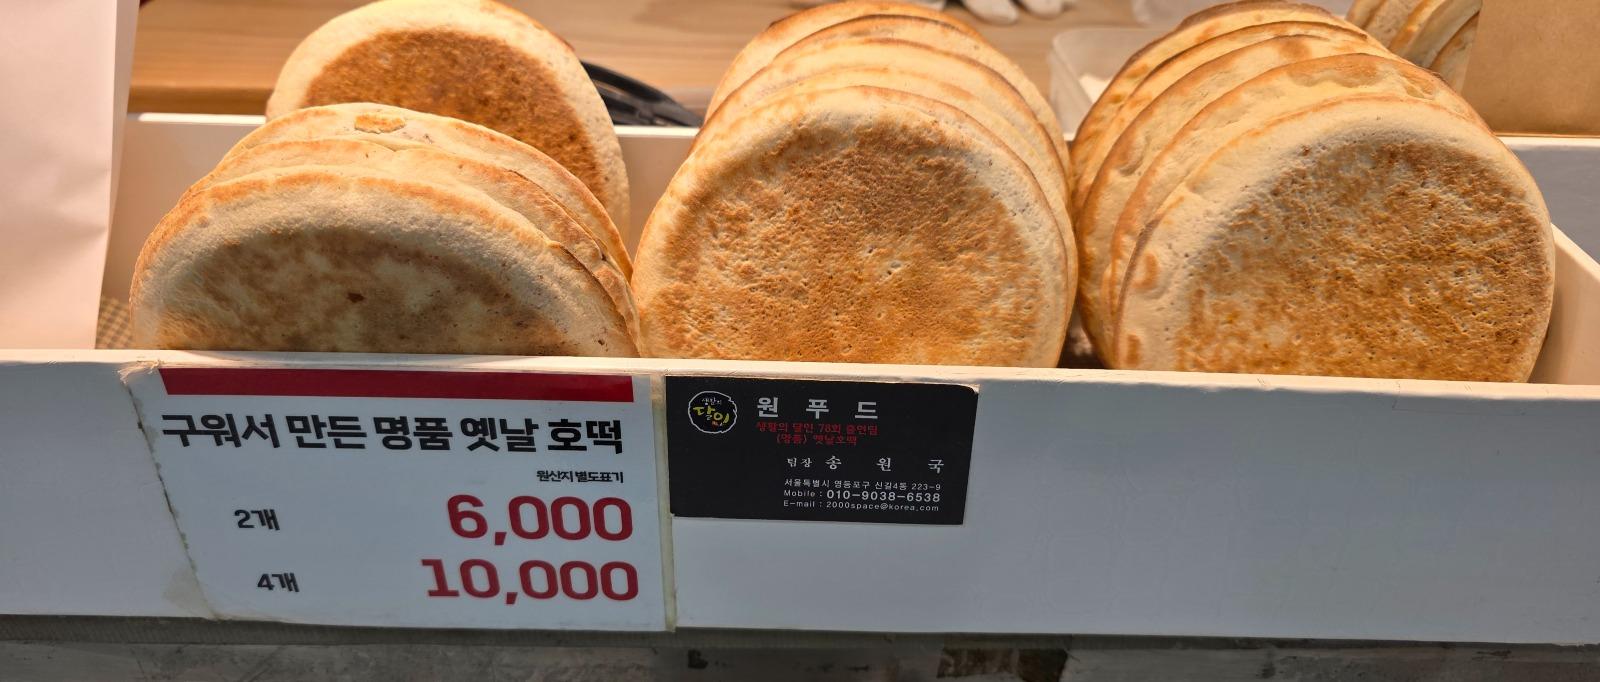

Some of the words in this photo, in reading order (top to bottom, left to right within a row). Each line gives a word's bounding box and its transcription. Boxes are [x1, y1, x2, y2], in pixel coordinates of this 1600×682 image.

[161, 413, 280, 449] 구워서
[287, 414, 368, 451] 만든
[373, 415, 453, 451] 명품
[460, 416, 539, 453] 옛날
[547, 418, 623, 455] 호떡
[818, 423, 841, 434] 78회
[787, 457, 813, 468] 팀장
[536, 470, 573, 483] 원산지
[574, 470, 624, 484] 별도표기
[784, 478, 830, 488] 서울특별시
[834, 480, 871, 489] 영등포구
[875, 481, 908, 490] 신길4동
[911, 483, 941, 491] 223-9
[826, 489, 941, 503] 010-9038-6538
[783, 500, 815, 508] E-mail
[826, 501, 940, 512] 2000space@korea.com
[233, 509, 280, 532] 2개
[447, 494, 633, 547] 6,000
[256, 571, 300, 594] 4개
[421, 559, 639, 606] 10,000
